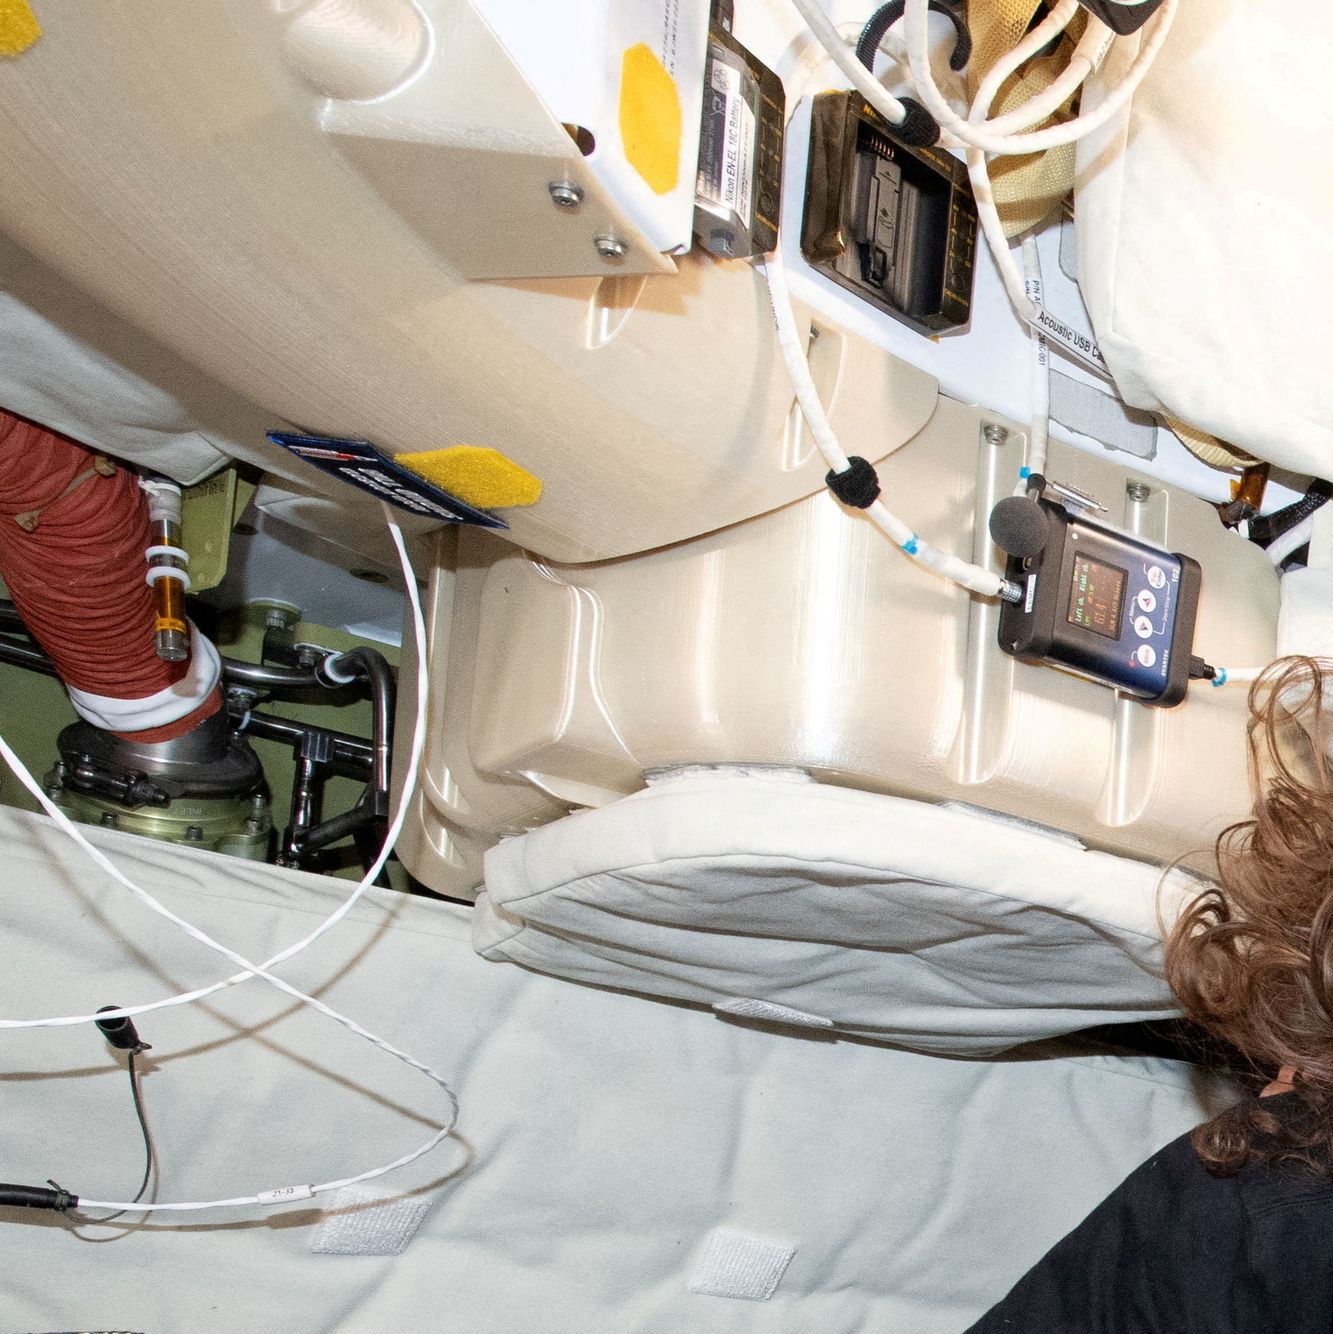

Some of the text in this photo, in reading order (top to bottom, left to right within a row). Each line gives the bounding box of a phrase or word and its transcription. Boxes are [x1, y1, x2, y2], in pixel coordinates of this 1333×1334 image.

[723, 95, 743, 203] Nikon EN-EL 18C Battery
[1038, 311, 1105, 364] Acoustic USB Ca
[1075, 606, 1083, 622] Left
[1079, 574, 1087, 592] Right
[1171, 568, 1180, 583] 102
[1161, 649, 1169, 677] SVANTEK
